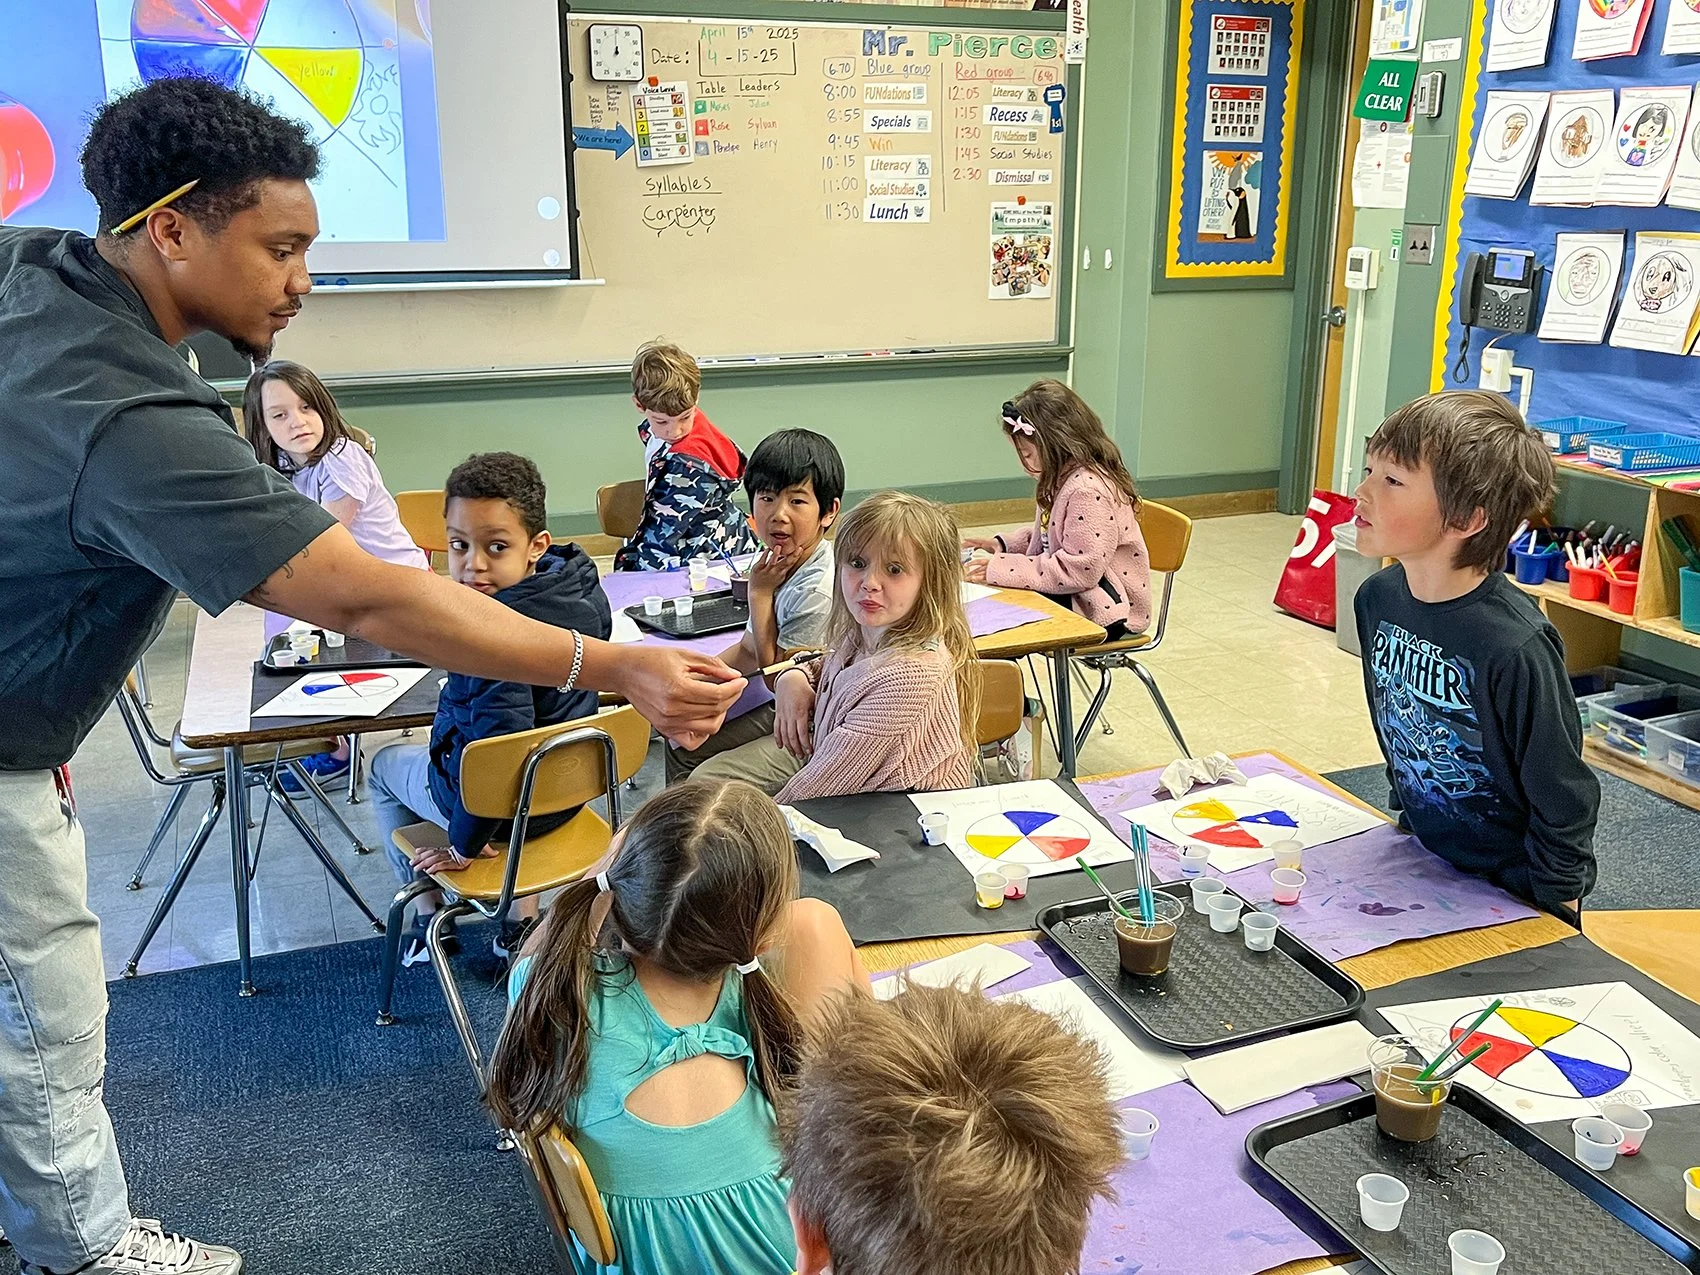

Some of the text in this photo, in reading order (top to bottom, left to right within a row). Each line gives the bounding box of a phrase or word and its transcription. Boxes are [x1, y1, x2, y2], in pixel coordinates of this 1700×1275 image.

[1073, 0, 1085, 34] ealth
[700, 27, 726, 44] April
[766, 28, 799, 40] 2025
[862, 29, 1058, 59] Mr. Pierce
[868, 58, 931, 80] Blue group
[955, 61, 1013, 83] Red group
[696, 78, 781, 94] Table Leaders
[1378, 72, 1401, 88] ALL
[642, 86, 659, 94] Voice
[823, 83, 857, 101] 8:00
[865, 85, 911, 100] FUNdations
[948, 86, 980, 100] 12:05
[993, 87, 1024, 99] Literacy
[636, 98, 642, 106] 4
[1364, 93, 1404, 112] CLEAR
[638, 111, 644, 119] 3
[827, 108, 861, 123] 8:55
[955, 106, 979, 120] 1:15
[989, 106, 1028, 122] Recess
[639, 124, 646, 132] 2
[871, 115, 912, 130] Specials
[955, 126, 981, 139] 1:30
[753, 138, 778, 154] Henry
[828, 133, 860, 150] 9:45
[869, 137, 893, 151] Win
[643, 149, 649, 157] 0
[955, 146, 980, 161] 1:45
[990, 147, 1053, 160] Social Studies
[822, 154, 855, 170] 10:15
[870, 158, 912, 173] Literacy
[953, 167, 982, 181] 2:30
[995, 171, 1035, 183] Dismissal
[645, 174, 712, 198] Syllables
[823, 176, 858, 194] 11:00
[869, 182, 915, 196] Social Studies
[643, 204, 716, 223] Carpenter
[825, 201, 859, 220] 11:30
[869, 203, 909, 220] Lunch
[1392, 625, 1443, 661] BLACK
[1372, 630, 1472, 709] PANTHER
